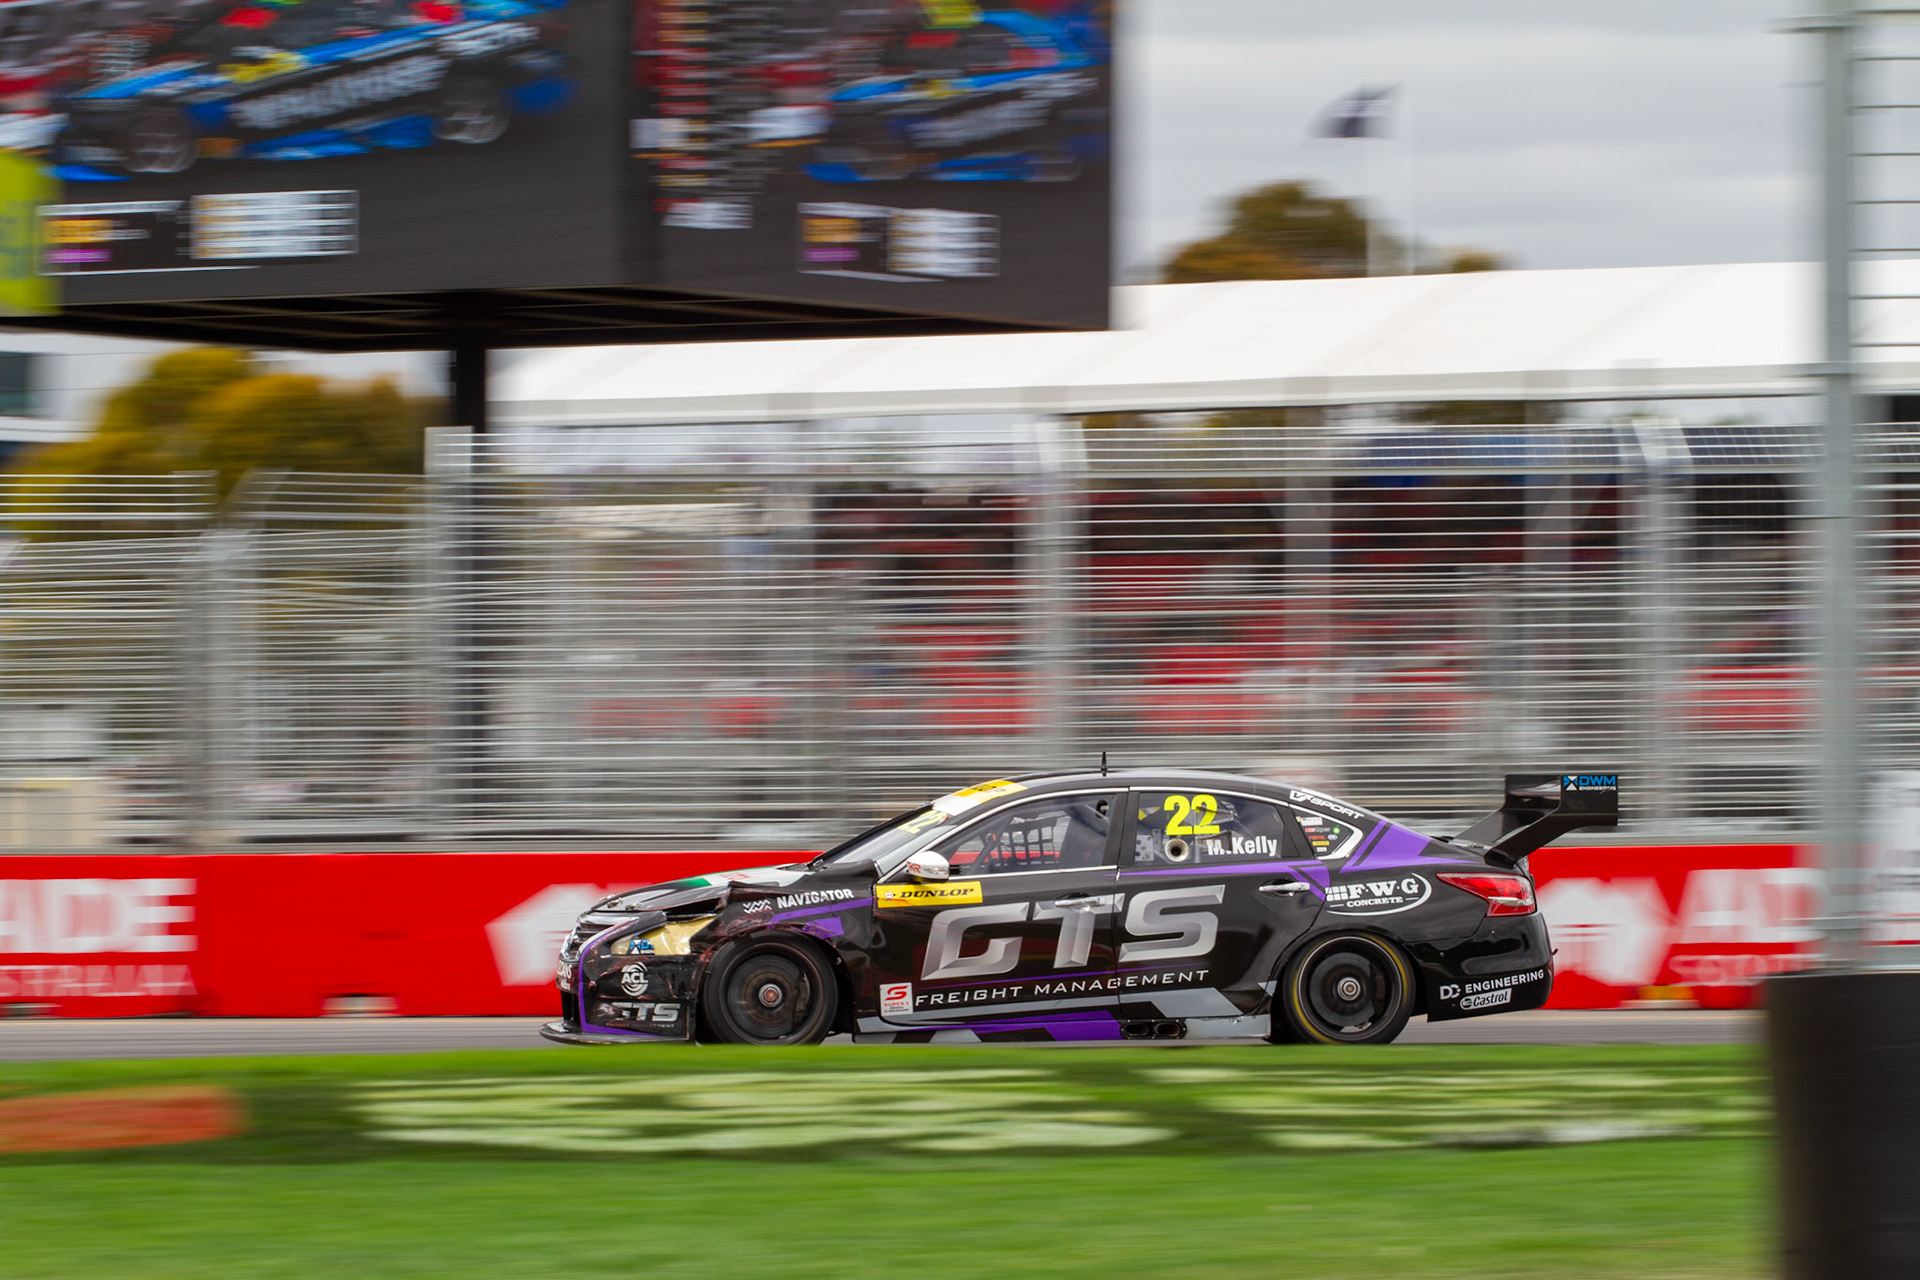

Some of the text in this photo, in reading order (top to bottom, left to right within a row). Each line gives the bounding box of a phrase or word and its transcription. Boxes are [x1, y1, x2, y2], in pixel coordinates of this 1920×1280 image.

[1579, 775, 1616, 786] DWM
[1164, 794, 1220, 835] 22
[1206, 836, 1277, 856] M.Kelly
[777, 889, 855, 909] NAVIGATOR
[900, 888, 974, 899] DUNLOP
[1346, 896, 1404, 908] CONCRETE
[921, 884, 1226, 980] GTS
[621, 971, 649, 983] ACL
[1033, 970, 1210, 996] MANAGEMENT
[1465, 969, 1544, 994] ENGINEERING
[915, 986, 1023, 1007] FREIGHT
[1473, 991, 1509, 1007] Castrol
